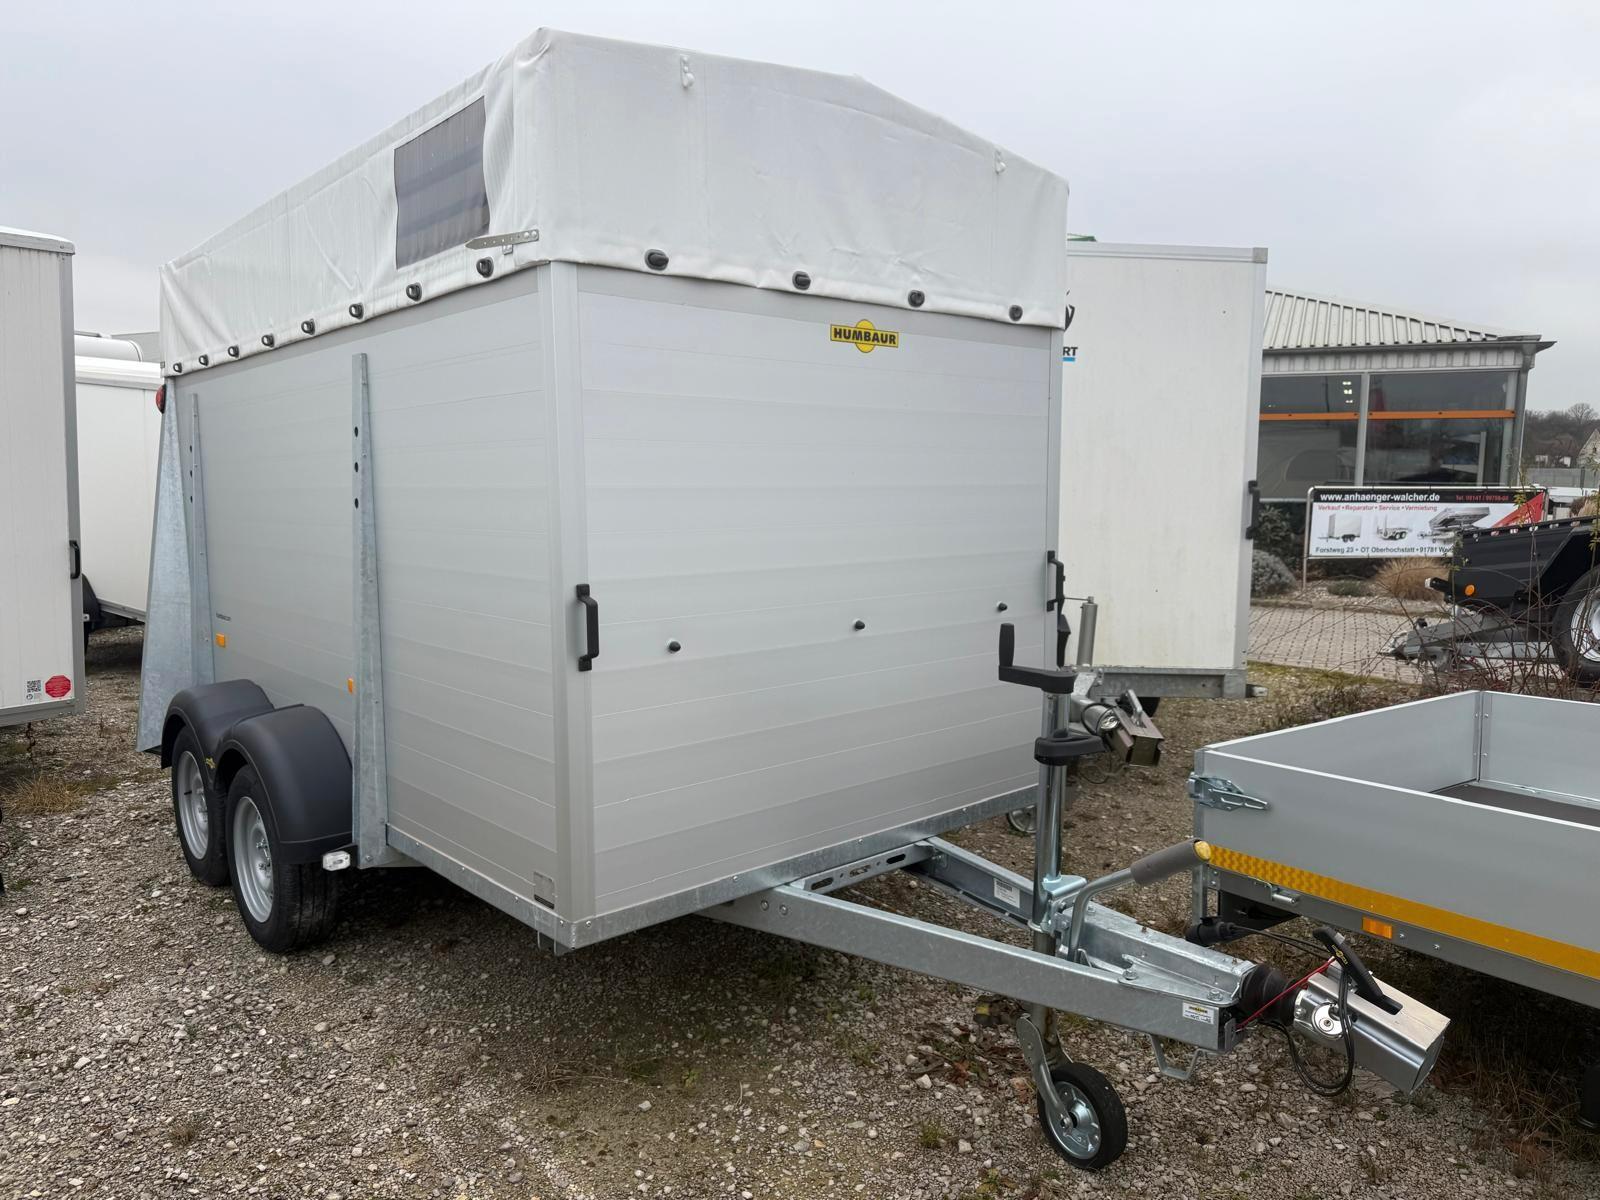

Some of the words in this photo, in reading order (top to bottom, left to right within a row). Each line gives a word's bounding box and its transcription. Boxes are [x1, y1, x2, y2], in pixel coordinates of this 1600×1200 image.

[833, 327, 897, 344] HUMBAUR
[1320, 493, 1440, 503] www.anhaenger-walcher.de
[1345, 504, 1374, 513] Reparatur
[1405, 504, 1438, 513] Vermietung
[1315, 547, 1345, 555] Forstweg
[1371, 546, 1415, 554] Oberhochstatt
